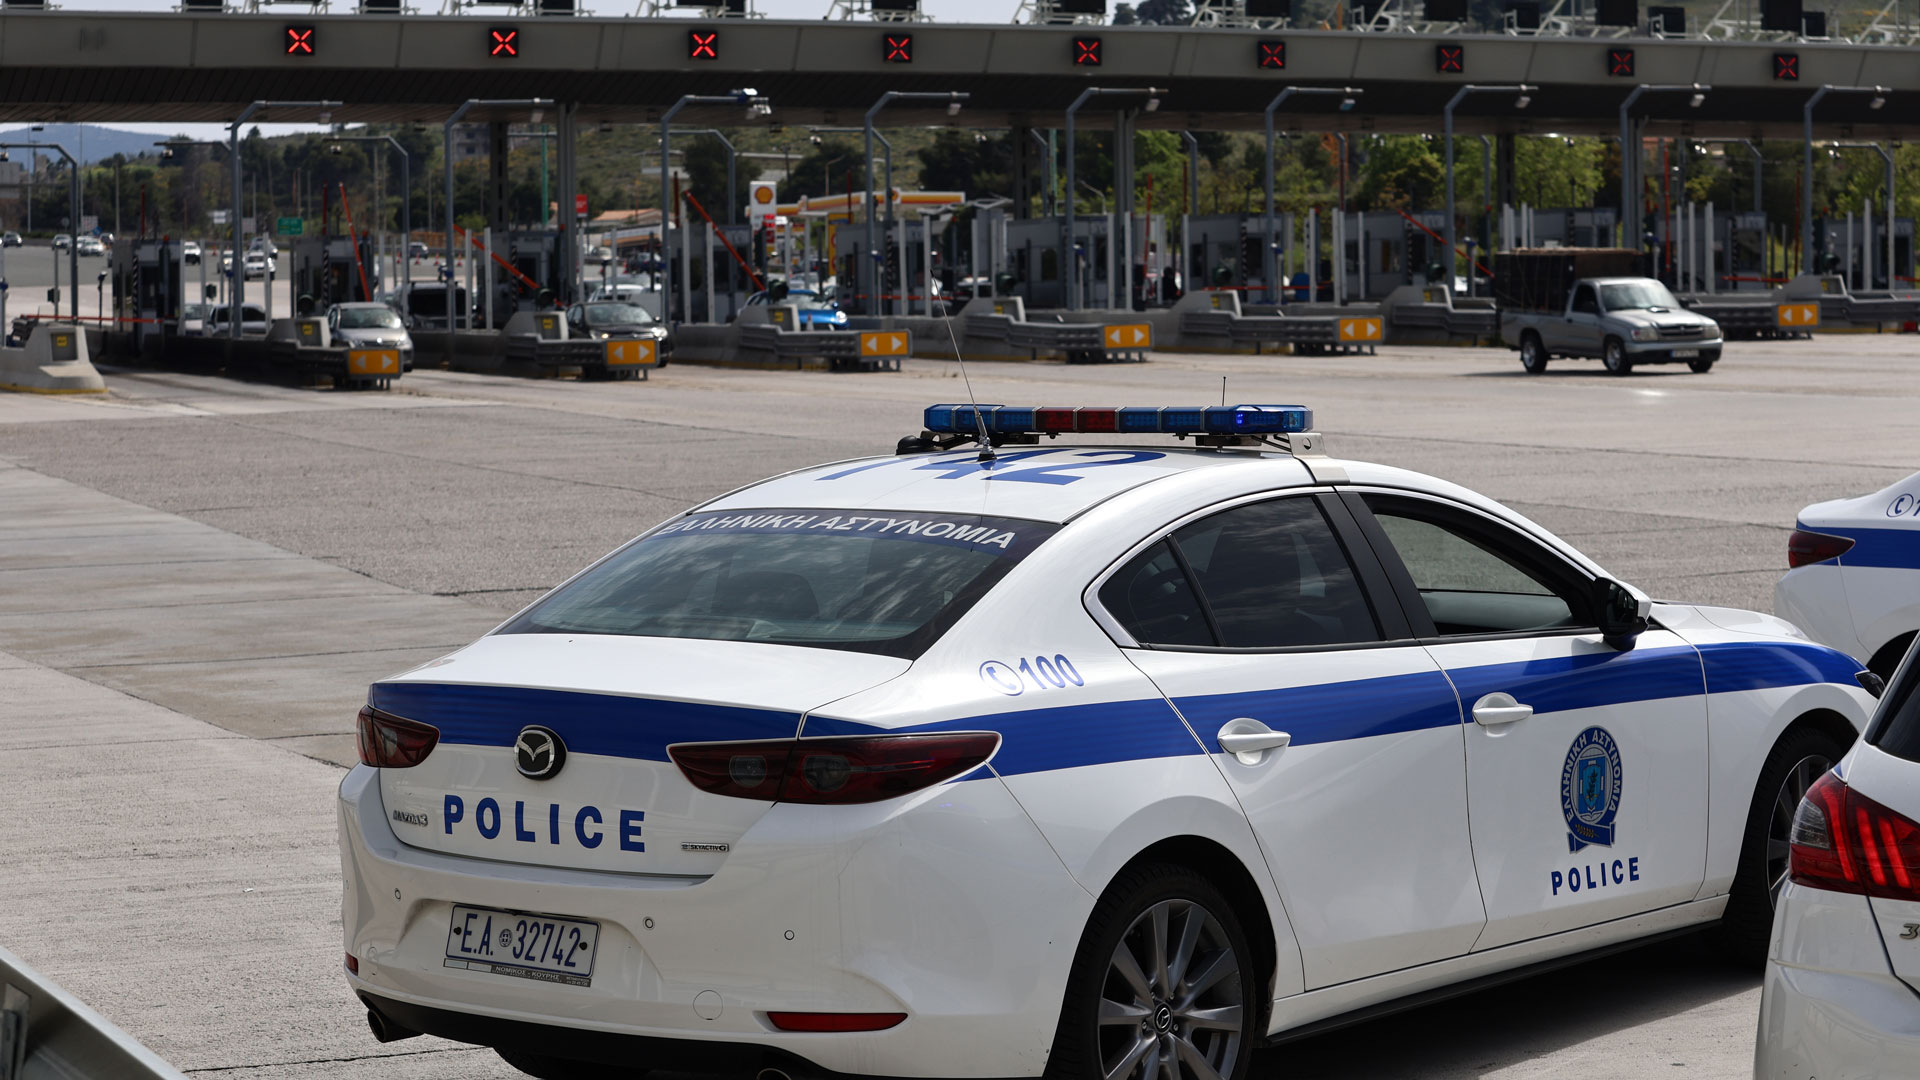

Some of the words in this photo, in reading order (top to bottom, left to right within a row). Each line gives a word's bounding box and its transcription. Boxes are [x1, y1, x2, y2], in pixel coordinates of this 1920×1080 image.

[808, 515, 1015, 549] ΑΣΤΥΝΟΜΙΑ
[1019, 653, 1084, 690] 100
[1562, 733, 1587, 823] ΕΛΛΗΝΙΚΗ
[1592, 729, 1621, 812] ΑΣΤΥΝΟΜΙΑ
[444, 794, 646, 853] POLICE
[1551, 857, 1640, 896] POLICE
[512, 919, 581, 968] 32742
